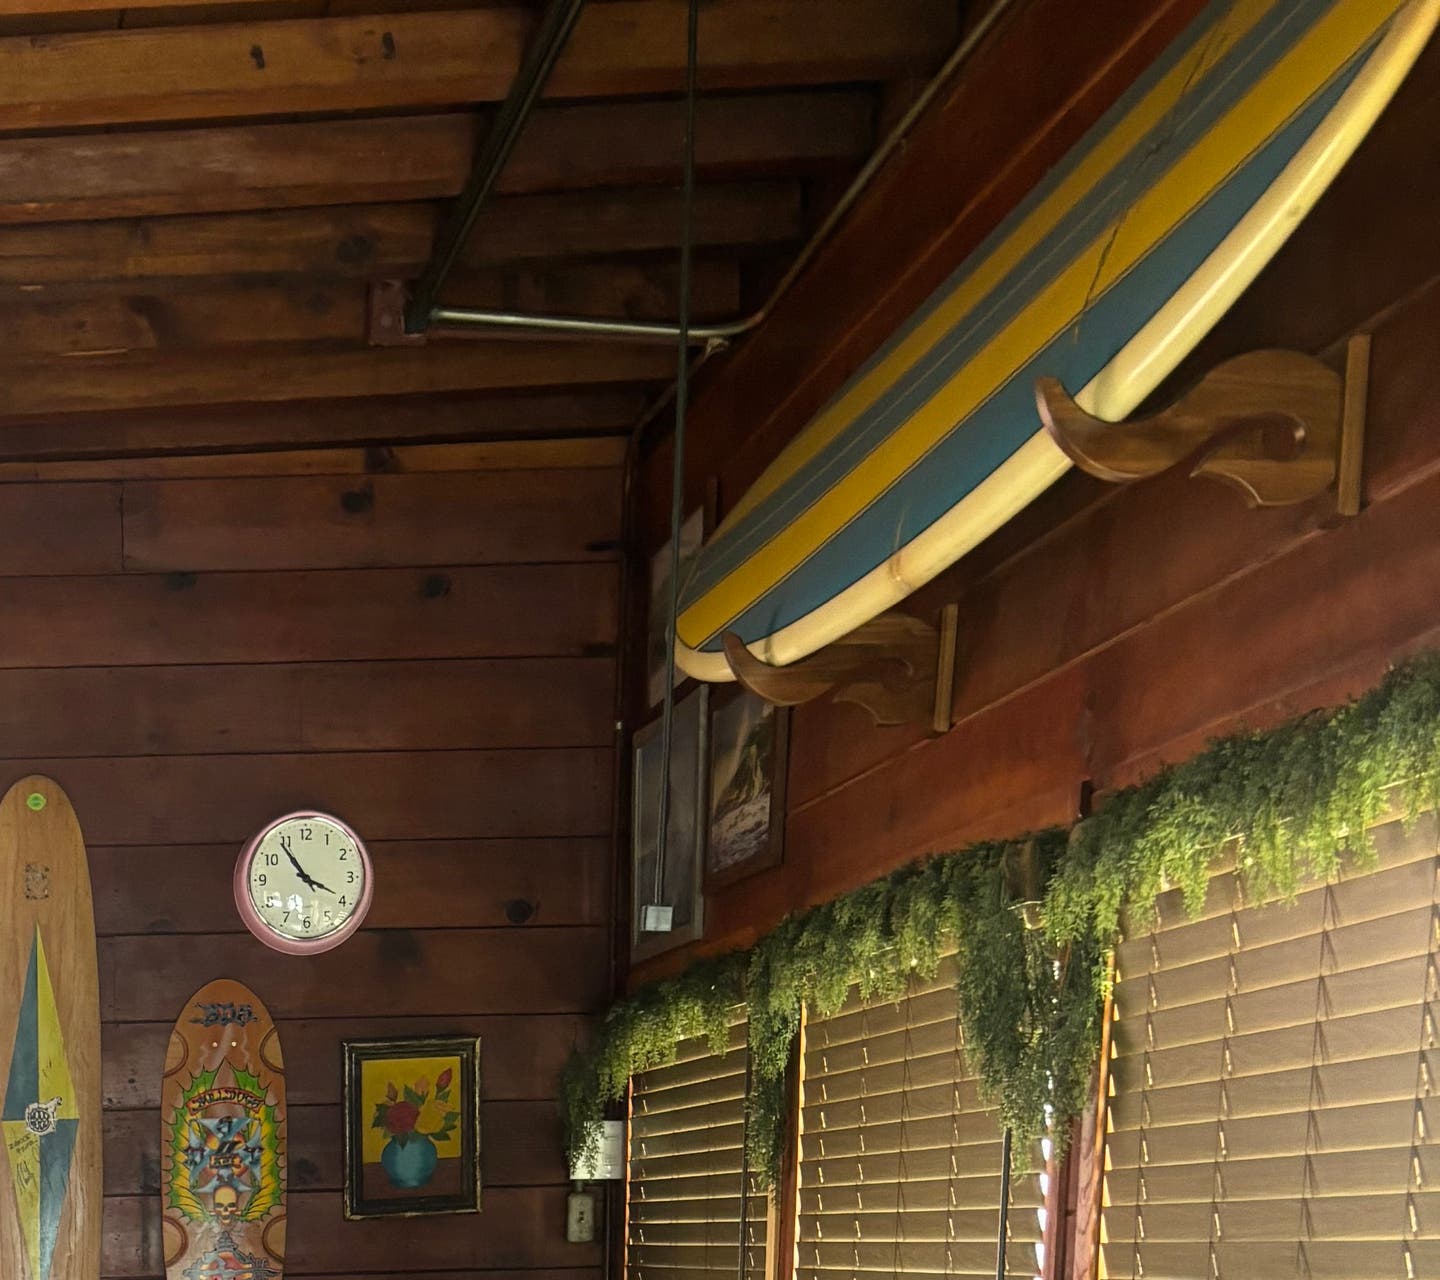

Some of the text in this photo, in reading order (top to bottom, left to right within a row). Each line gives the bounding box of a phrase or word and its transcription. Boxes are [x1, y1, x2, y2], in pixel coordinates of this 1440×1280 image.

[300, 828, 312, 840] 12
[324, 833, 329, 846] 1
[280, 836, 291, 848] 11
[265, 853, 279, 866] 10
[339, 848, 347, 861] 2
[258, 874, 267, 886] 9
[347, 871, 354, 883] 3
[338, 895, 346, 907] 4
[283, 911, 290, 923] 7
[324, 910, 331, 922] 5
[303, 916, 311, 929] 6
